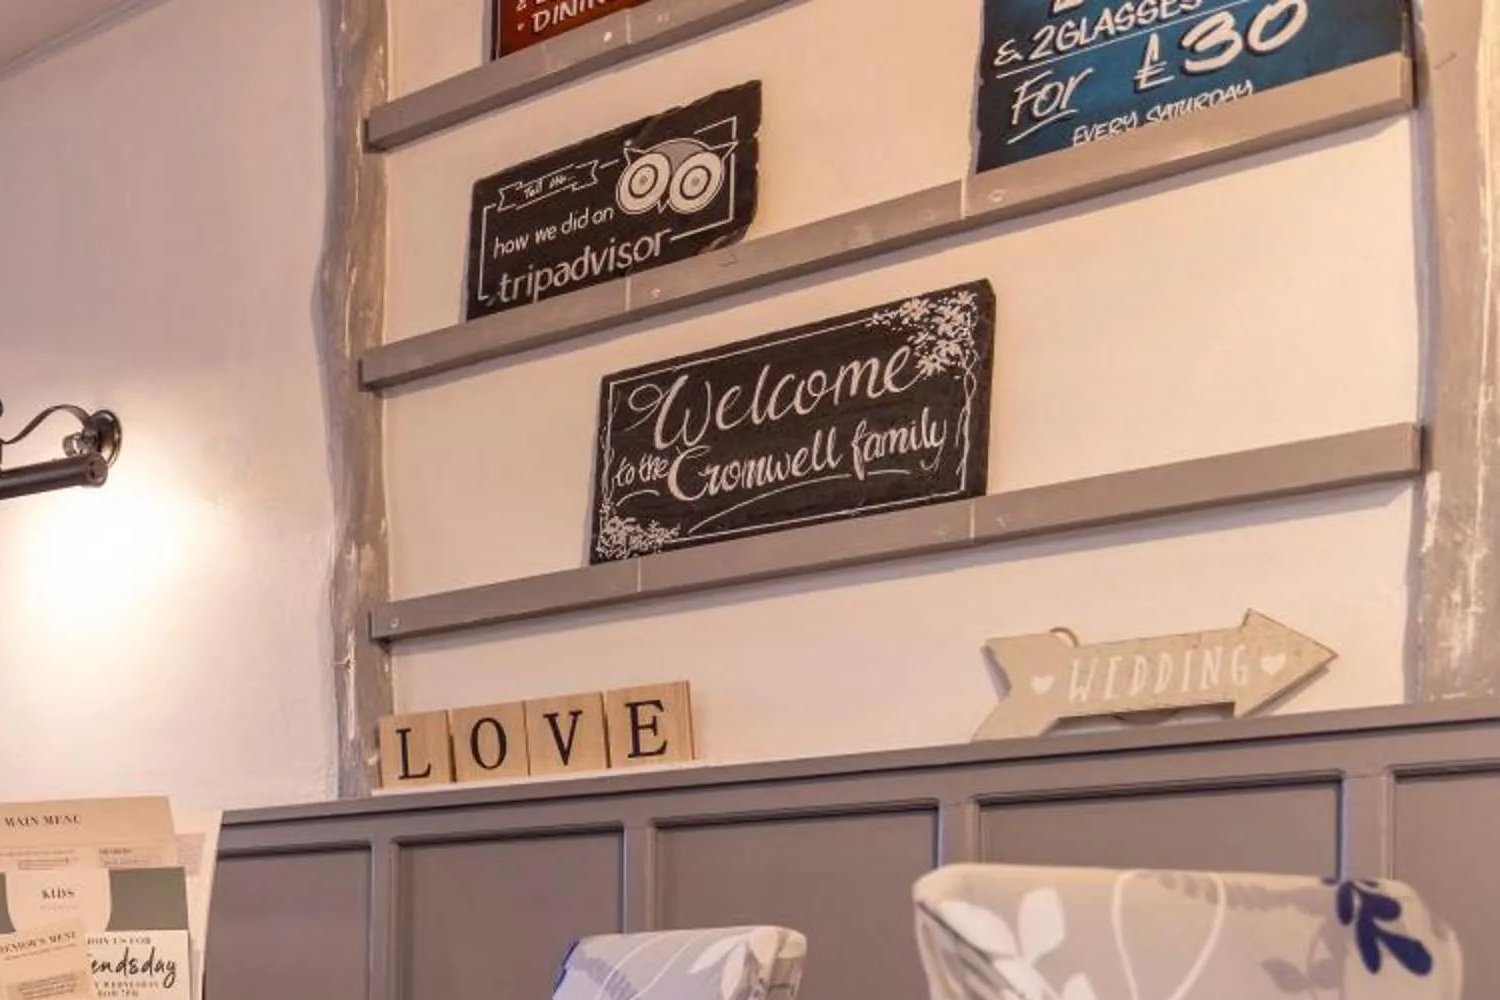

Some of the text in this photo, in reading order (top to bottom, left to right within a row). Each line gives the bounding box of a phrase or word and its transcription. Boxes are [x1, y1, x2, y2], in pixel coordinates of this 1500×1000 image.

[1072, 79, 1254, 147] EVERY SATURDAY
[493, 206, 614, 258] how we did on
[500, 228, 672, 303] tripadvisor
[626, 346, 918, 450] Welcome
[614, 407, 948, 501] to the Cromwell family
[1068, 644, 1249, 702] WEDDING
[396, 700, 668, 780] LOVE
[4, 814, 81, 827] MAIN MENU
[42, 888, 75, 899] KIDS
[91, 945, 177, 988] endsday
